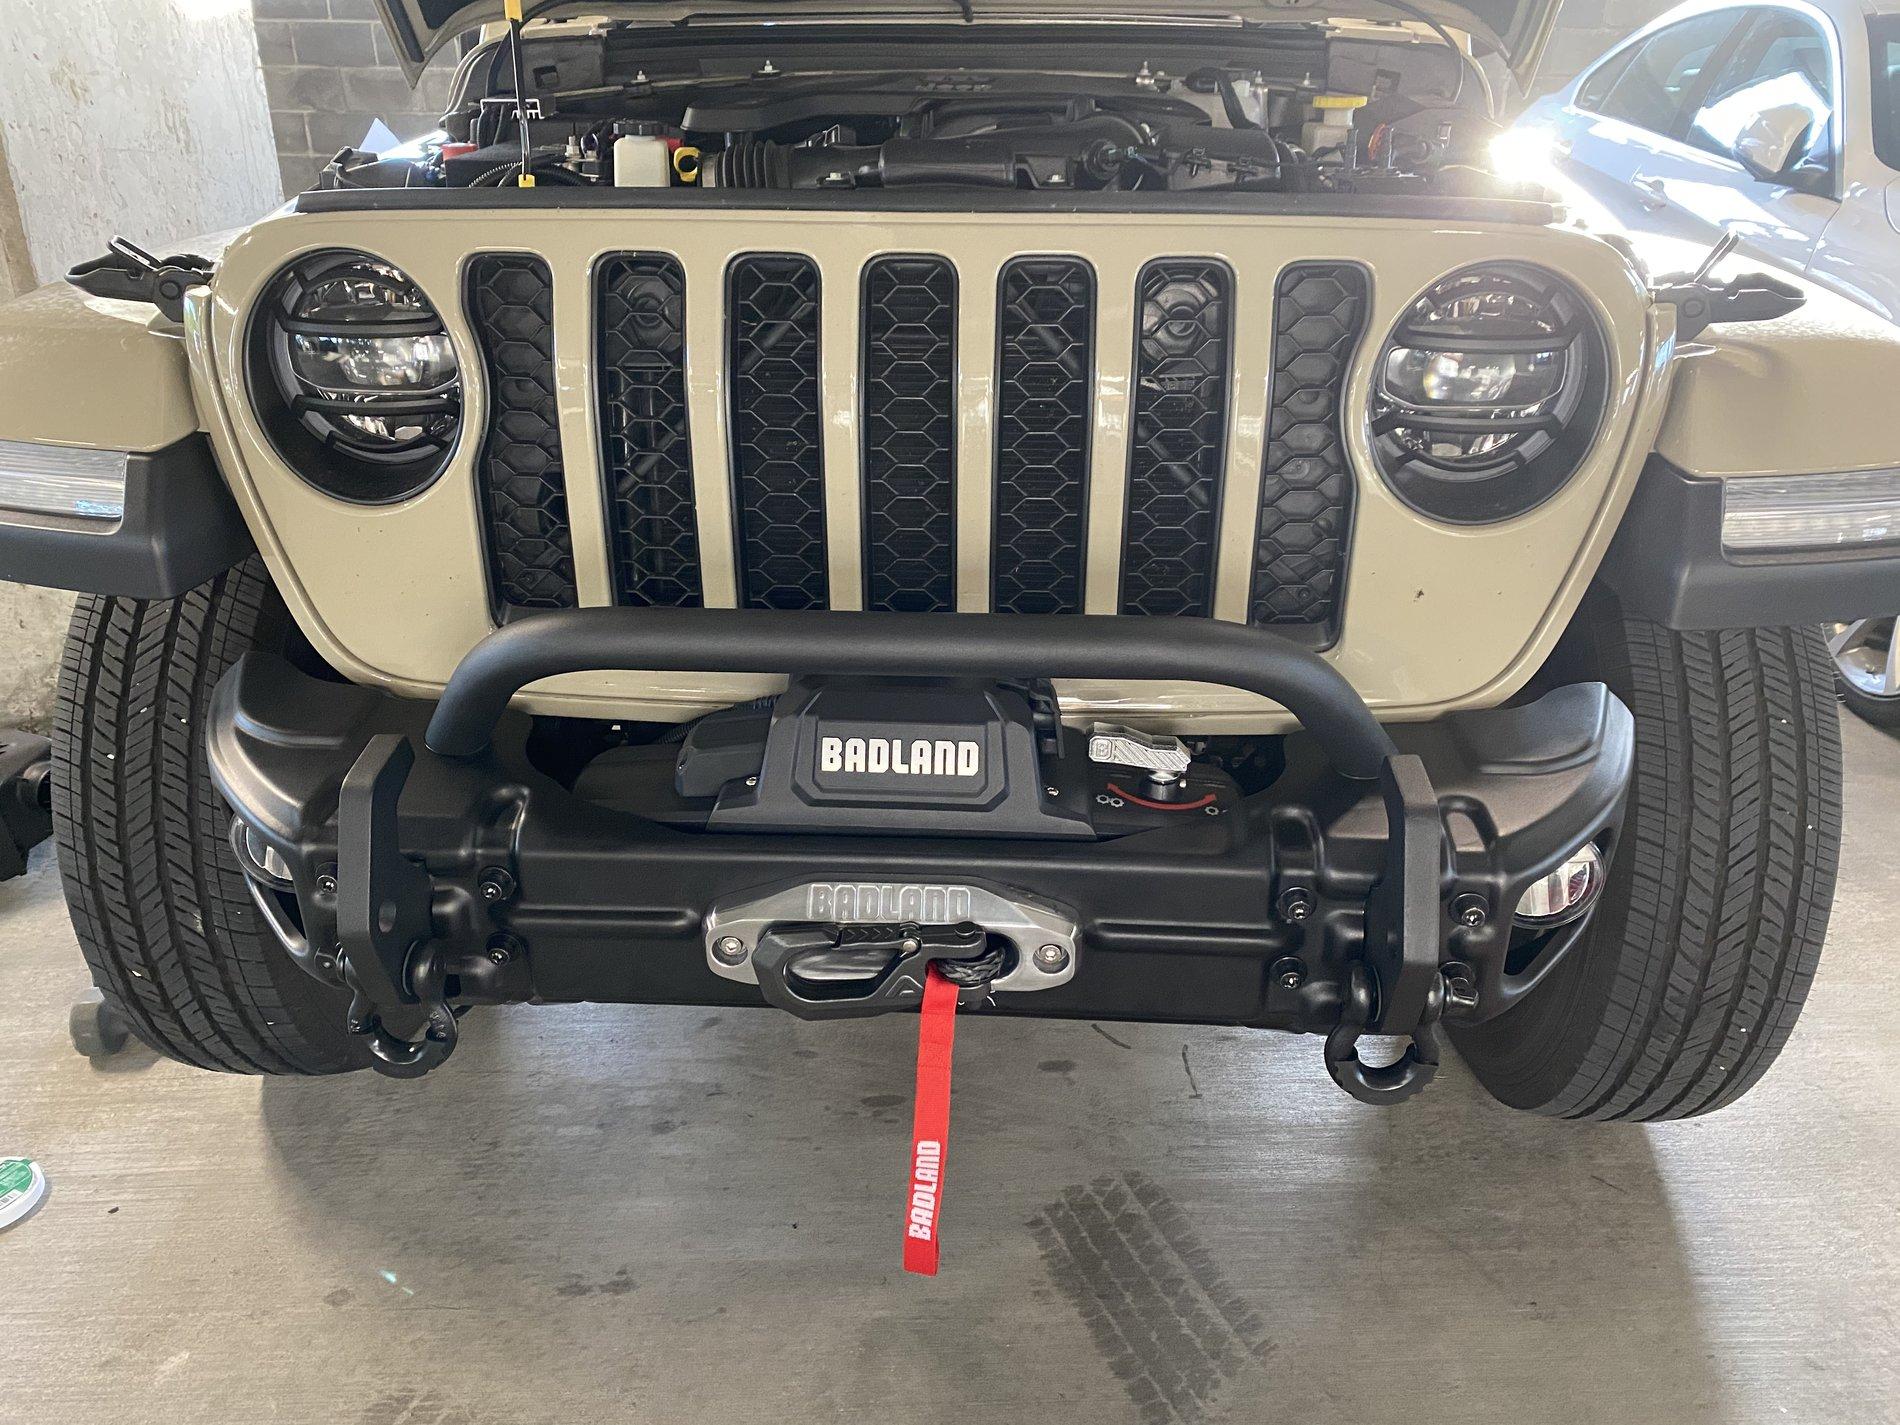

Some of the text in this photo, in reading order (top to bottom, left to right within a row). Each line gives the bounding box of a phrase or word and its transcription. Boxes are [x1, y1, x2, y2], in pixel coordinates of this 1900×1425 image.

[821, 737, 979, 776] BADLAND
[808, 883, 971, 922] BADLAND
[908, 1140, 941, 1241] BADLAND
